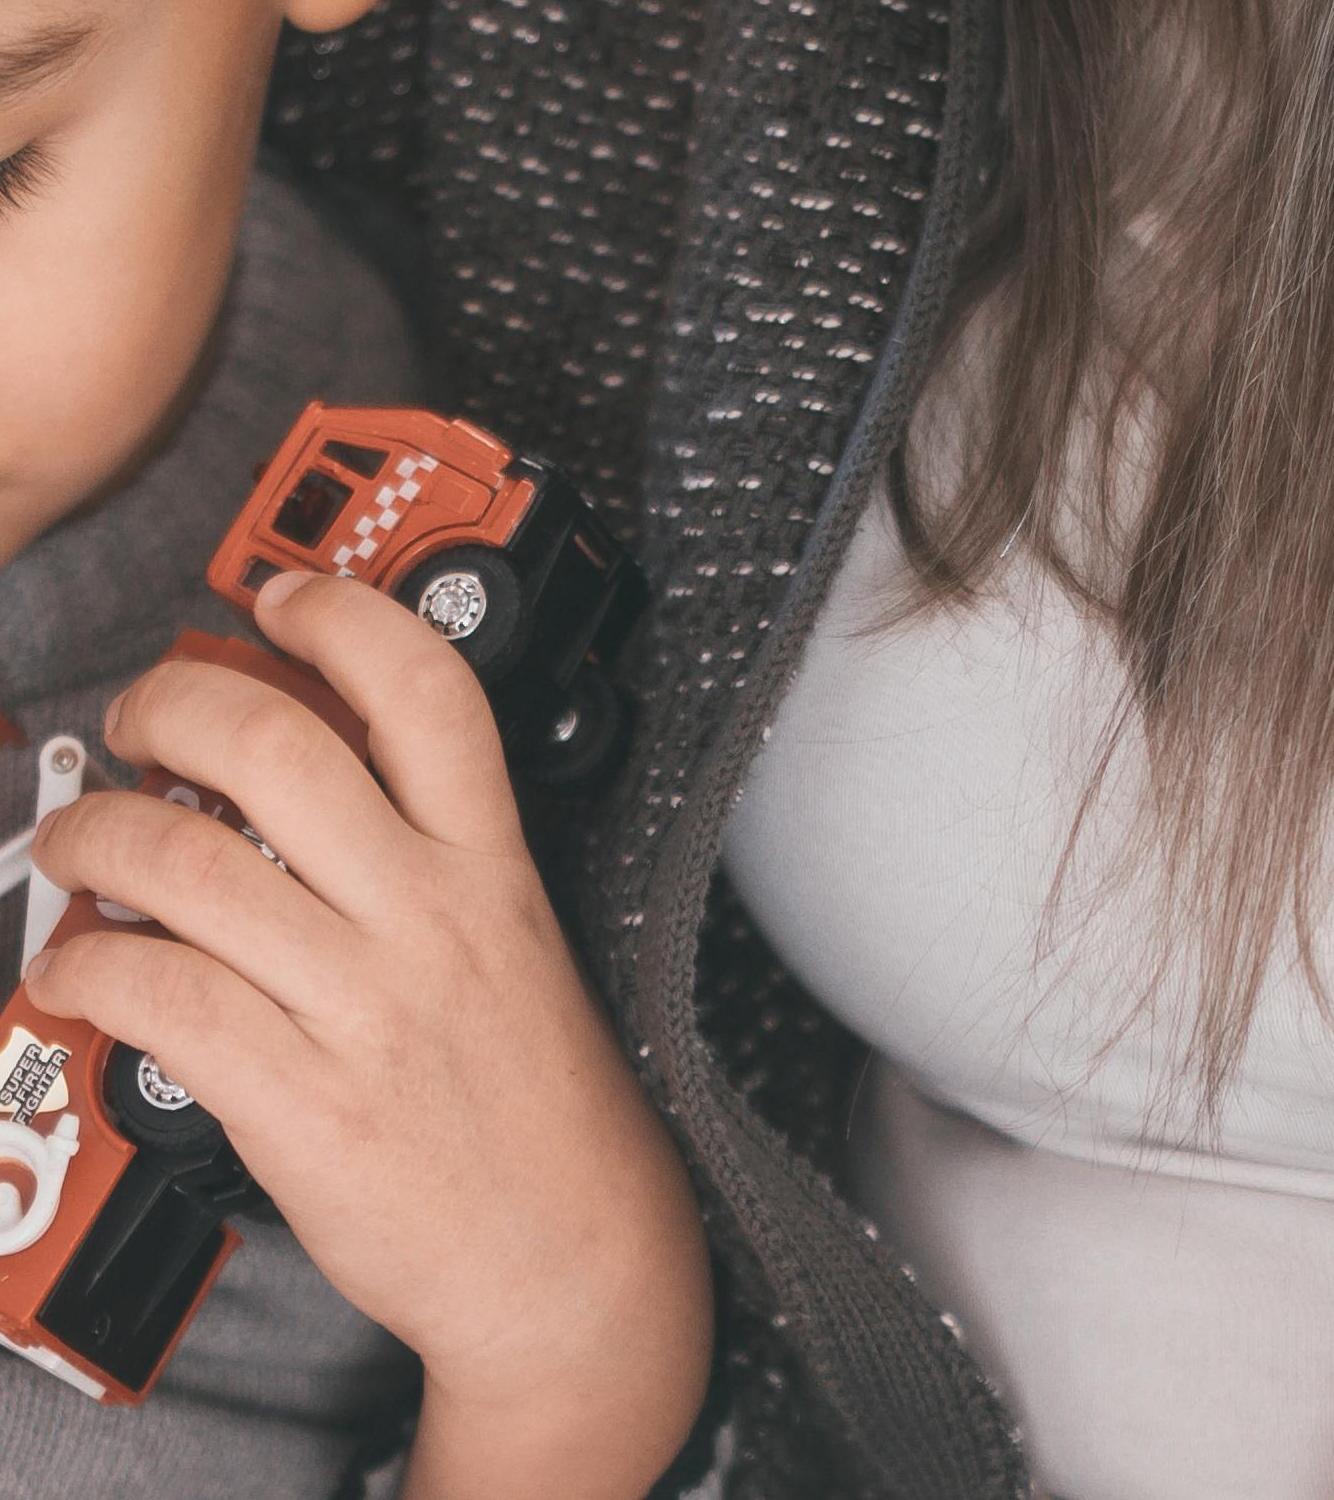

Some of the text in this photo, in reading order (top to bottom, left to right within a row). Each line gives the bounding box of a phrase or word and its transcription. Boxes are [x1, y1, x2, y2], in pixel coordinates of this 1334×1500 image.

[0, 1044, 41, 1104] SUPER
[16, 1061, 45, 1102] FIRE
[16, 1050, 68, 1125] FIGHTER
